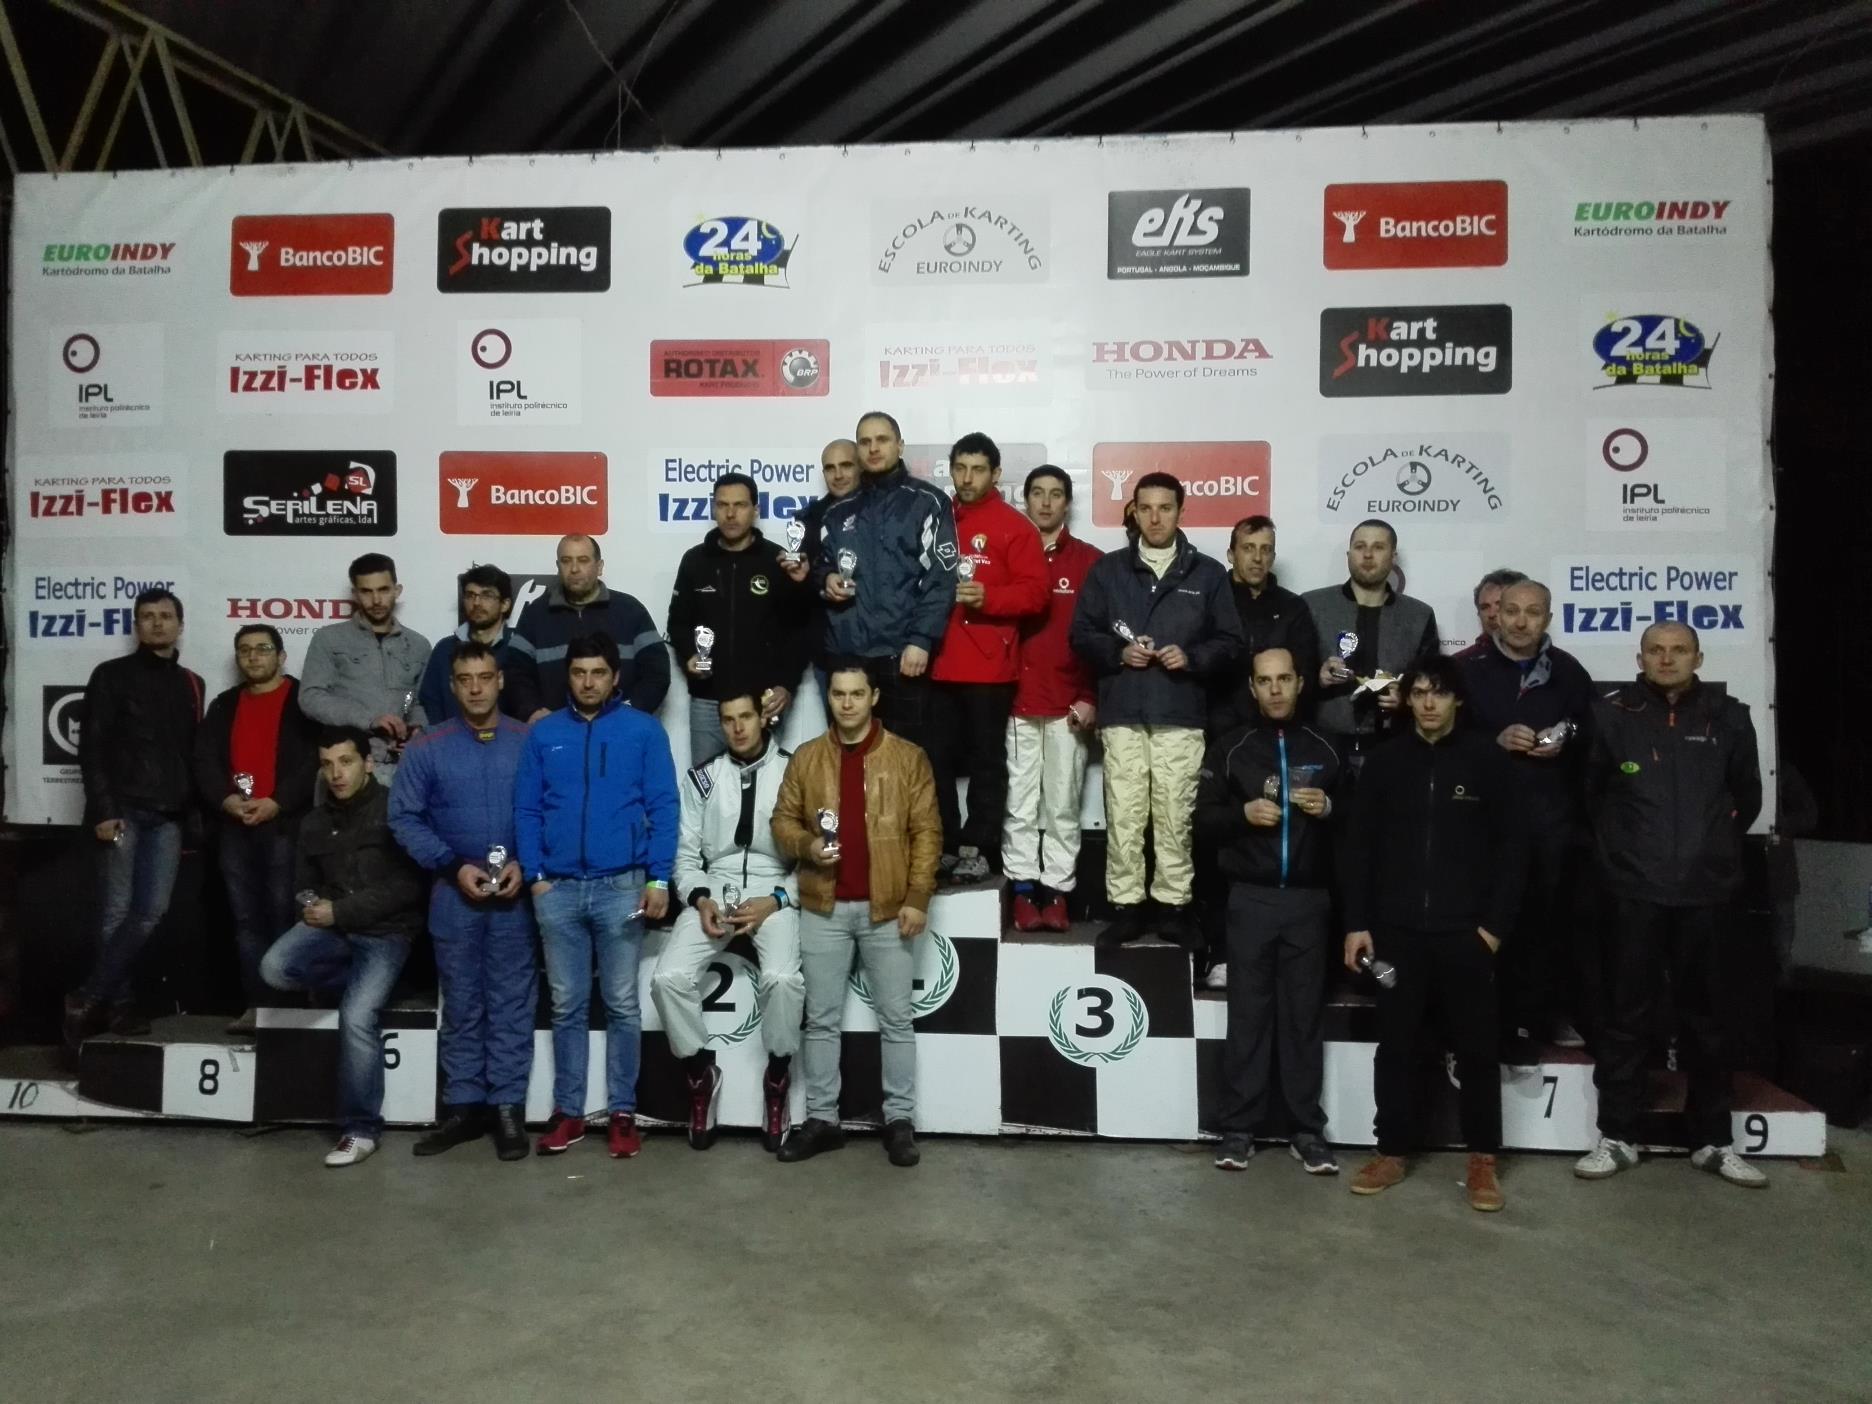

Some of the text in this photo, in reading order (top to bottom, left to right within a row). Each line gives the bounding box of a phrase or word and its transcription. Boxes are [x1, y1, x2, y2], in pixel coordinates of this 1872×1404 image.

[1574, 200, 1731, 221] EUROINDY
[480, 217, 544, 240] Kart
[1379, 215, 1497, 238] BancoBIC
[1574, 224, 1727, 237] Kartódromo da Batalha
[698, 220, 762, 257] 24
[878, 210, 945, 274] ESCOLA
[963, 206, 1042, 271] KARTING
[42, 243, 176, 262] EUROINDY
[280, 246, 384, 267] BancoBIC
[448, 230, 598, 276] Shopping
[42, 265, 171, 277] Kartódromo da Batalha
[695, 262, 779, 275] da Batalha
[916, 260, 1004, 274] EUROINDY
[1117, 265, 1154, 274] PORTUGAL
[1158, 264, 1188, 273] ANGOLA
[1367, 317, 1438, 342] Kart
[1609, 318, 1681, 357] 24
[235, 352, 378, 362] KARTING PARA TODOS
[884, 344, 1037, 356] KARTING PARA TODOS
[1092, 338, 1274, 363] HONDA
[1331, 331, 1498, 380] Shopping
[230, 364, 380, 393] Izzi-Flex
[664, 359, 760, 379] ROTAX
[796, 369, 818, 377] BRP
[1107, 366, 1258, 380] The Power of Dreams
[1606, 363, 1699, 376] da Batalha
[79, 383, 114, 403] IPL
[489, 380, 527, 400] IPL
[34, 475, 172, 487] KARTING PARA TODOS
[348, 475, 368, 487] SL
[750, 459, 815, 483] Power
[1326, 447, 1398, 512] ESCOLA
[1418, 444, 1503, 511] KARTING
[490, 485, 598, 505] BancoBIC
[1181, 476, 1259, 497] ncoBIC
[1622, 483, 1666, 504] IPL
[30, 488, 175, 519] Izzi-Flex
[1367, 499, 1461, 513] EUROINDY
[295, 514, 317, 525] artes
[358, 514, 372, 524] lda
[35, 576, 107, 600] Electric
[1570, 566, 1739, 592] Electric Power
[226, 598, 353, 620] HOND
[1563, 600, 1745, 633] Izzi-Flex
[29, 608, 133, 638] Izzi-Fl
[277, 624, 310, 636] ower
[702, 962, 737, 1013] 2
[1075, 986, 1116, 1039] 3
[199, 1058, 220, 1096] 8
[9, 1082, 39, 1110] 10
[1542, 1075, 1558, 1119] 7
[1744, 1113, 1770, 1153] 9
